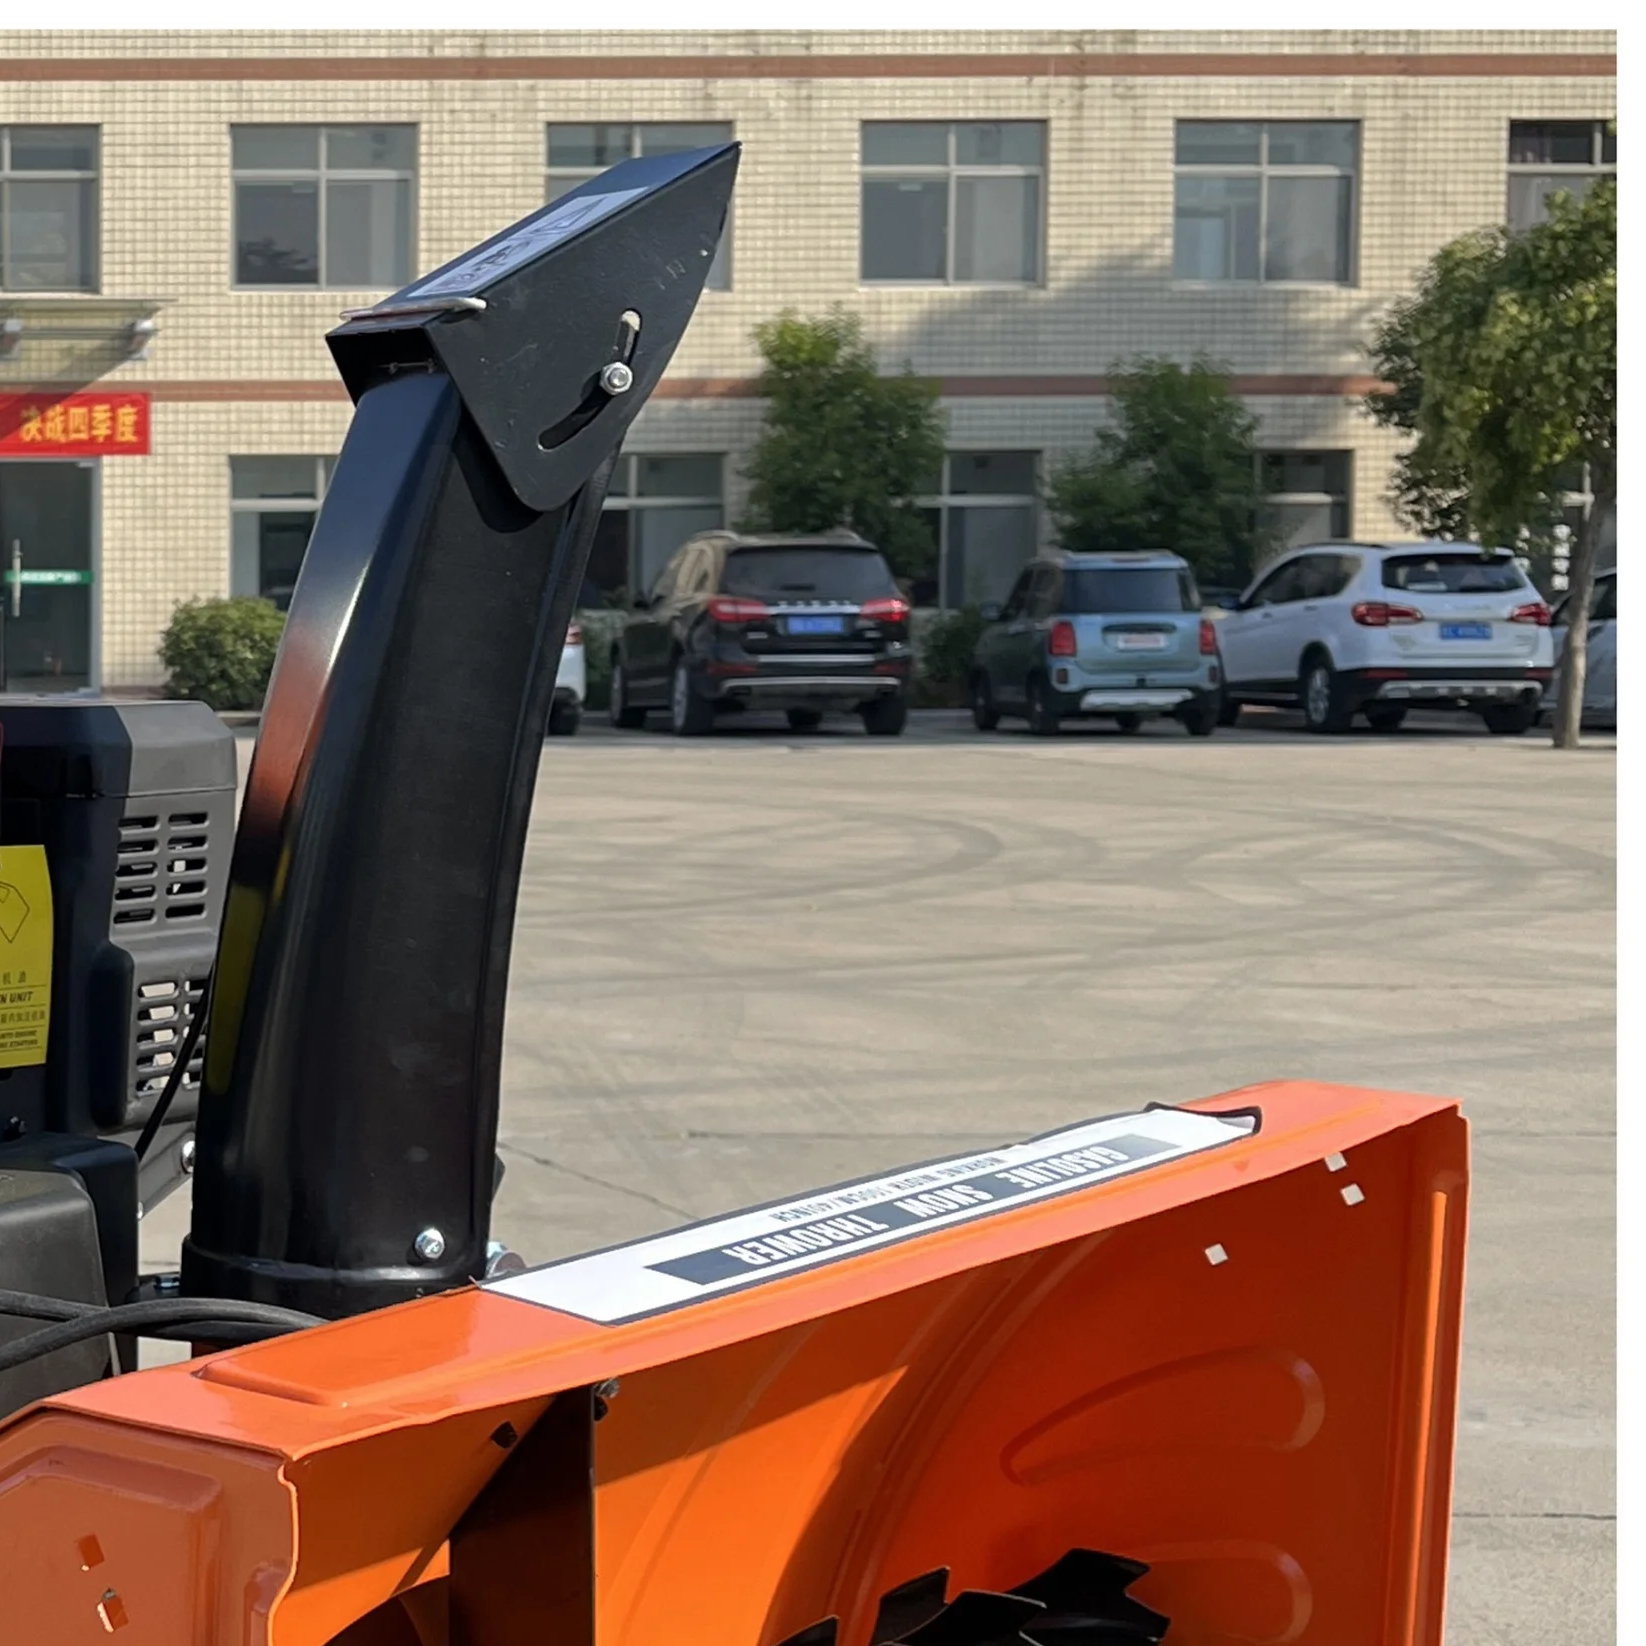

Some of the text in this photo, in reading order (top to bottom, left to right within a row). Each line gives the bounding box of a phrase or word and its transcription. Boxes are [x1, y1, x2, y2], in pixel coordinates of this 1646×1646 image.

[20, 403, 139, 443] 决战四季度
[9, 990, 34, 1003] UNIT
[721, 1145, 1130, 1266] GASOLINE SNOW THROWER
